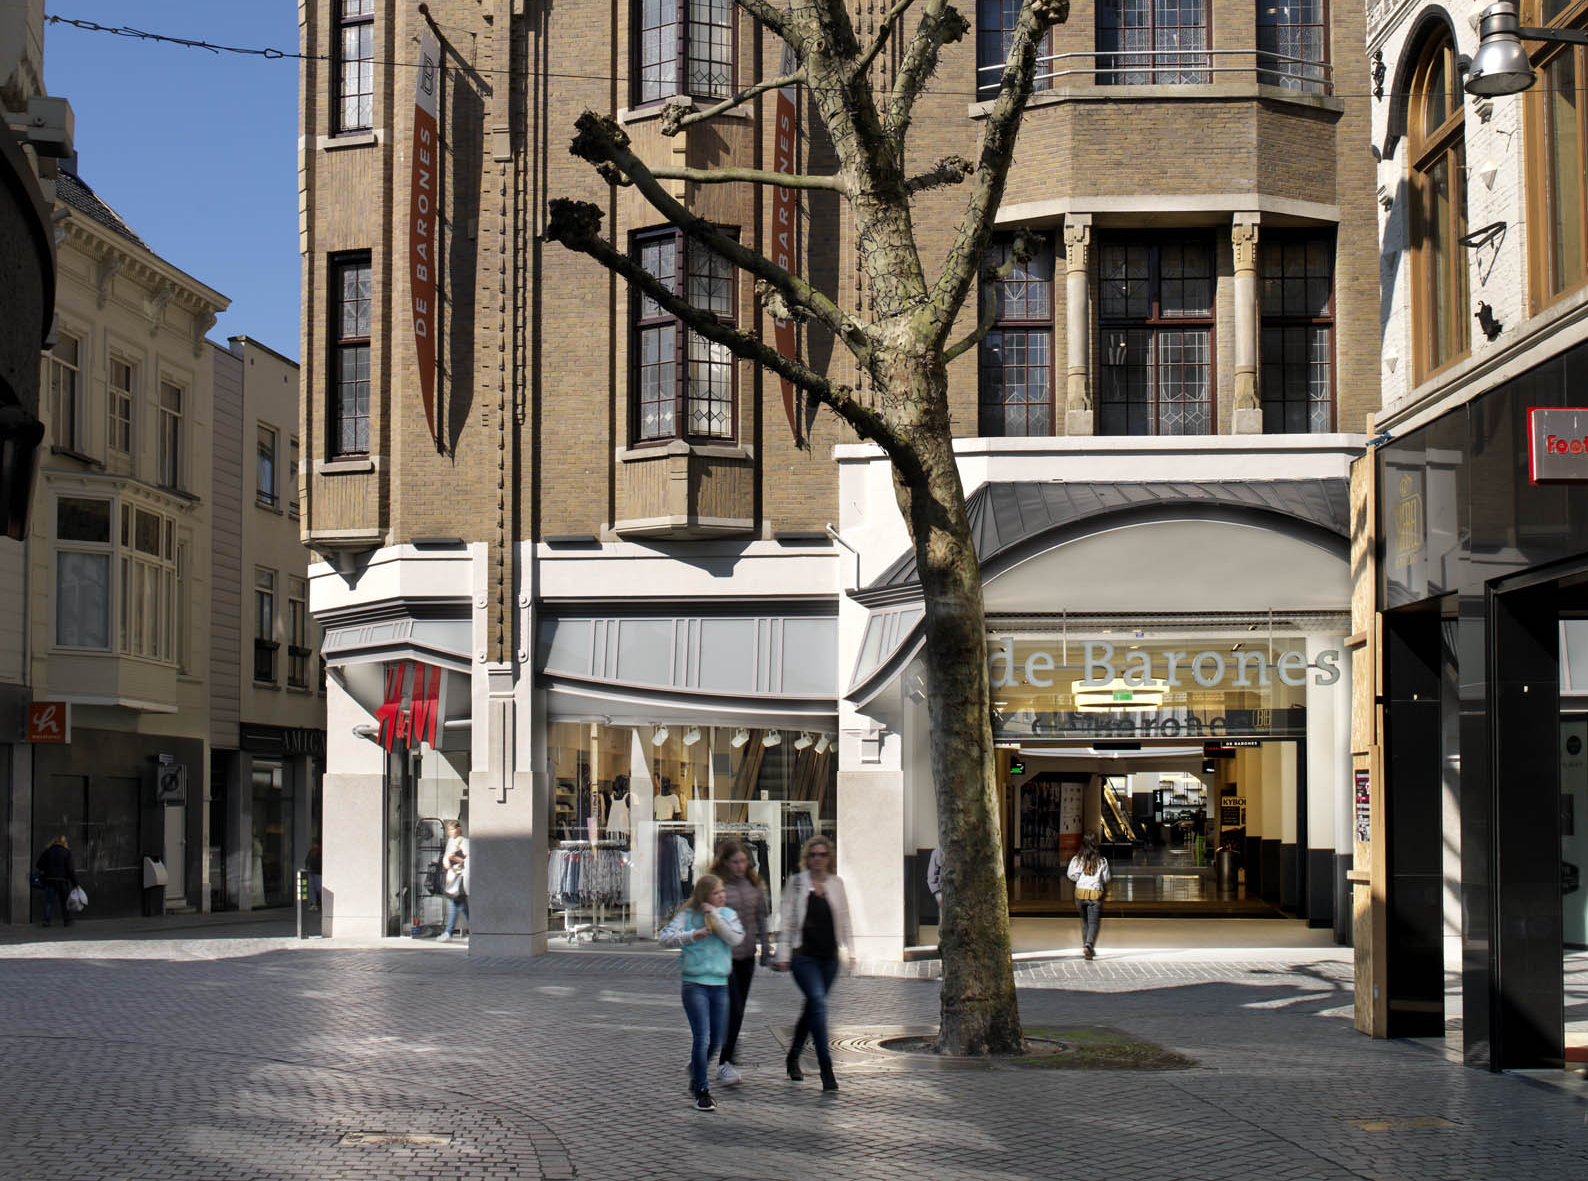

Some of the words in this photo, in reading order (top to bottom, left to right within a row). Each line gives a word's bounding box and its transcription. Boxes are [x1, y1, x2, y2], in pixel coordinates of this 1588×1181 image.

[416, 128, 431, 282] BARONES
[416, 298, 427, 339] DE
[988, 637, 1055, 687] de
[1079, 640, 1341, 687] Barones
[375, 662, 441, 754] H&M
